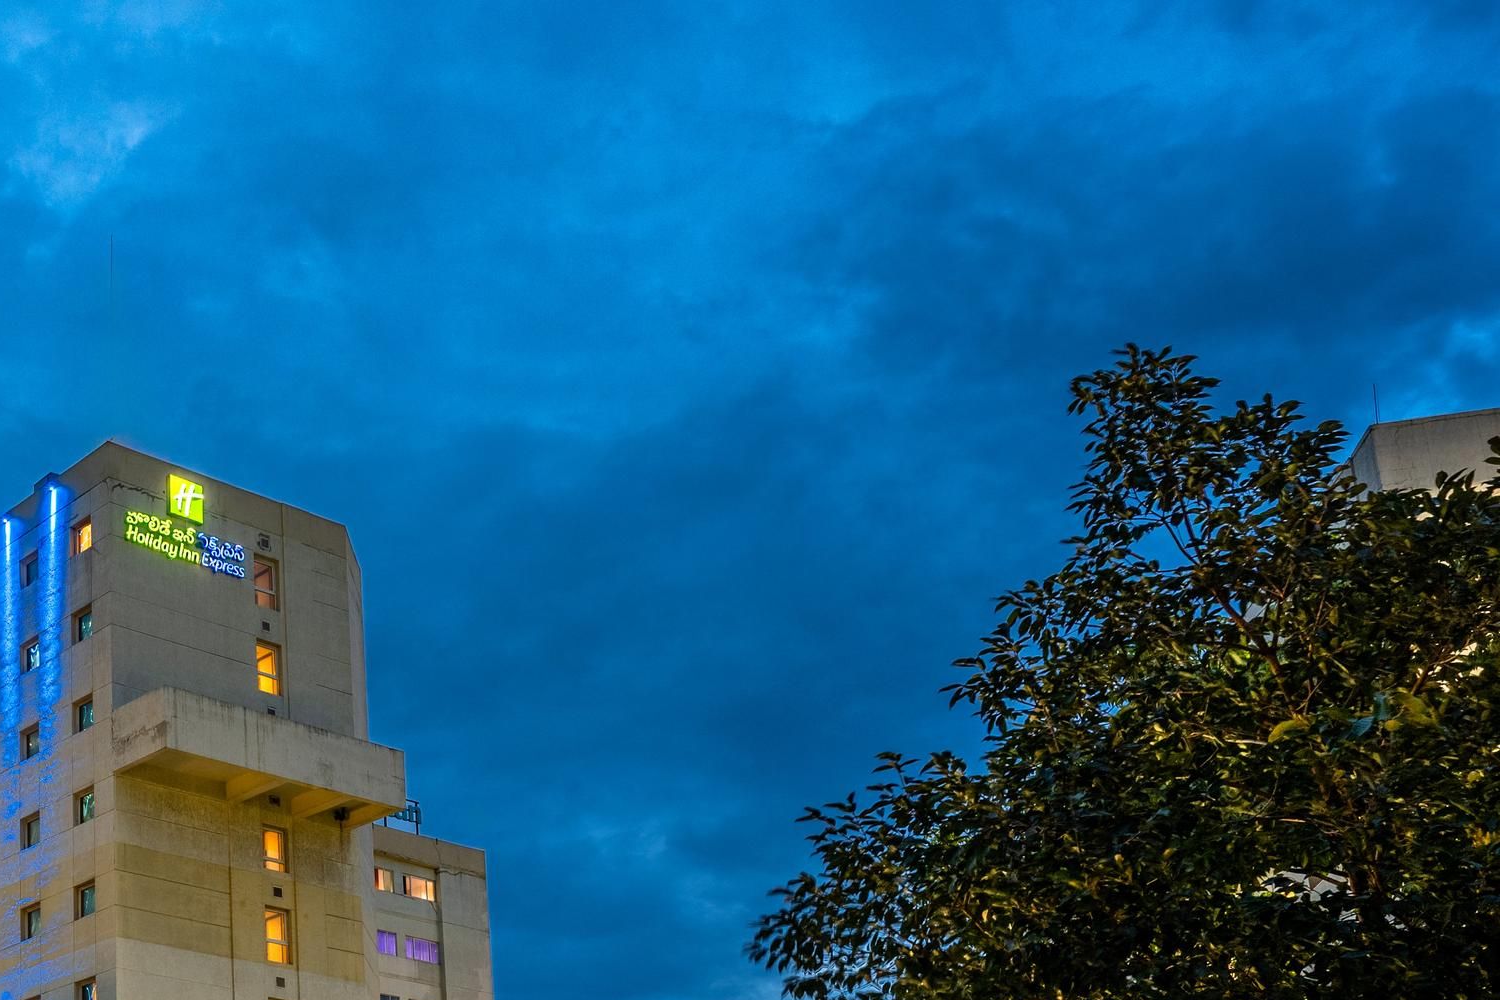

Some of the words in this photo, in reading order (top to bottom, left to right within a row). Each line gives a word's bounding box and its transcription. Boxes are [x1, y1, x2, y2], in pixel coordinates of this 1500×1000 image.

[126, 524, 180, 560] Holiday
[179, 542, 200, 565] Inn
[201, 551, 245, 579] Express
